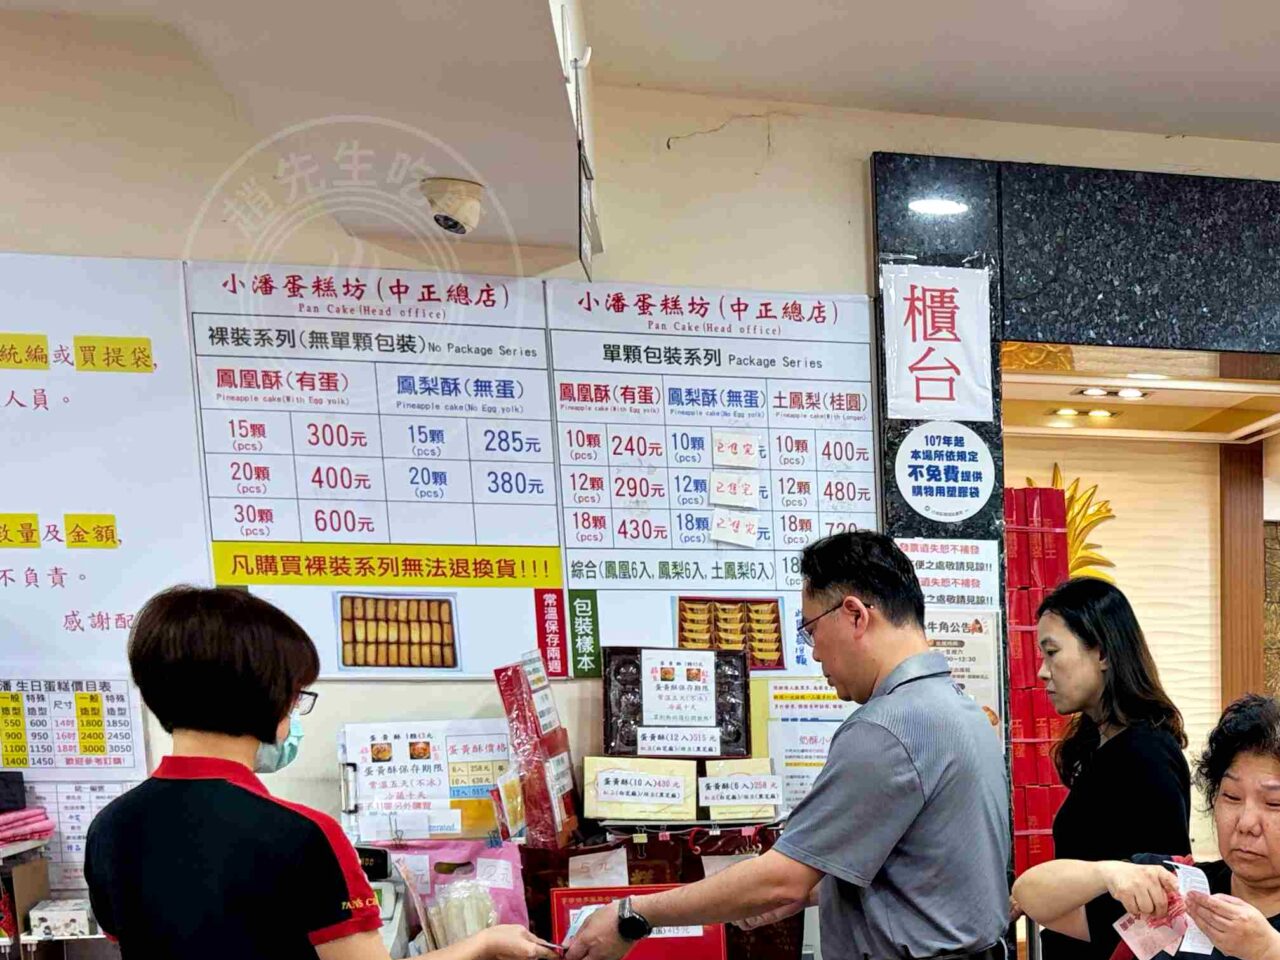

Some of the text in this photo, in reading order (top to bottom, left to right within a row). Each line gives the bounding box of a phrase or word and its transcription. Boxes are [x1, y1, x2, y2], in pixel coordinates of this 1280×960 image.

[222, 273, 509, 308] 小潘蛋糕坊(中正總店)
[298, 303, 319, 314] Pan
[400, 307, 446, 320] office)
[578, 291, 839, 325] 小潘蛋糕坊(中正總店)
[647, 320, 667, 331] Pan
[739, 324, 781, 336] office)
[208, 325, 427, 355] 裸裝系列(無單顆包裝)
[447, 343, 493, 357] Package
[499, 345, 538, 358] Series
[903, 284, 962, 404] 櫃台
[602, 343, 823, 369] 單顆包裝系列 Package Series
[215, 368, 350, 393] 鳳凰酥(有蛋)
[396, 375, 525, 400] 鳳梨酥(無蛋)
[559, 382, 662, 405] 鳳凰酥(有蛋)
[668, 387, 766, 409] 鳳梨酥(無蛋)
[773, 391, 868, 413] 土鳳梨(桂圓)
[228, 419, 266, 439] 15顆
[307, 423, 367, 447] 300元
[408, 425, 445, 445] 15顆
[232, 440, 263, 452] (pcs)
[483, 429, 542, 453] 285元
[566, 429, 601, 448] 10顆
[611, 436, 663, 457] 240元
[671, 433, 705, 451] 10顆
[776, 435, 808, 454] 10顆
[925, 434, 964, 448] 107年起
[412, 446, 441, 458] (pcs)
[570, 449, 598, 461] (pcs)
[674, 452, 702, 464] (pcs)
[822, 441, 869, 461] 400元
[910, 449, 978, 464] 本場所依規定
[778, 455, 806, 466] (pcs)
[230, 462, 270, 482] 20顆
[311, 466, 371, 489] 400元
[409, 467, 448, 487] 20顆
[908, 464, 982, 483] 不免費提供
[236, 483, 267, 495] (pcs)
[487, 471, 545, 495] 380元
[570, 473, 604, 492] 12顆
[614, 477, 665, 498] 290元
[674, 475, 708, 493] 12顆
[778, 478, 811, 496] 12顆
[823, 481, 871, 502] 480元
[912, 484, 979, 499] 購物用塑膠袋
[415, 488, 444, 500] (pcs)
[573, 493, 601, 504] (pcs)
[677, 494, 704, 506] (pcs)
[781, 496, 808, 508] (pcs)
[234, 504, 274, 524] 30顆
[314, 509, 375, 533] 600元
[572, 512, 606, 530] 18顆
[676, 513, 710, 531] 18顆
[240, 525, 271, 537] (pcs)
[617, 519, 668, 540] 430元
[780, 515, 813, 533] 18顆
[575, 531, 603, 543] (pcs)
[679, 532, 706, 544] (pcs)
[783, 534, 810, 545] (pcs)
[232, 554, 549, 579] 凡購買裸裝系列無法退換貨!!!
[924, 595, 994, 605] 之處敬請見諒!!
[542, 593, 562, 674] 常溫保存兩週
[573, 598, 596, 672] 包裝樣本
[924, 620, 973, 634] 牛角公告
[4, 719, 21, 728] 550
[30, 719, 47, 728] 600
[80, 719, 103, 728] 1800
[106, 719, 130, 728] 1850
[5, 732, 22, 740] 900
[31, 732, 48, 740] 950
[81, 732, 104, 740] 2400
[107, 732, 130, 740] 2450
[4, 744, 26, 753] 1100
[30, 744, 53, 753] 1150
[82, 744, 105, 753] 3000
[108, 744, 132, 753] 3050
[5, 757, 28, 765] 1400
[31, 757, 54, 765] 1450
